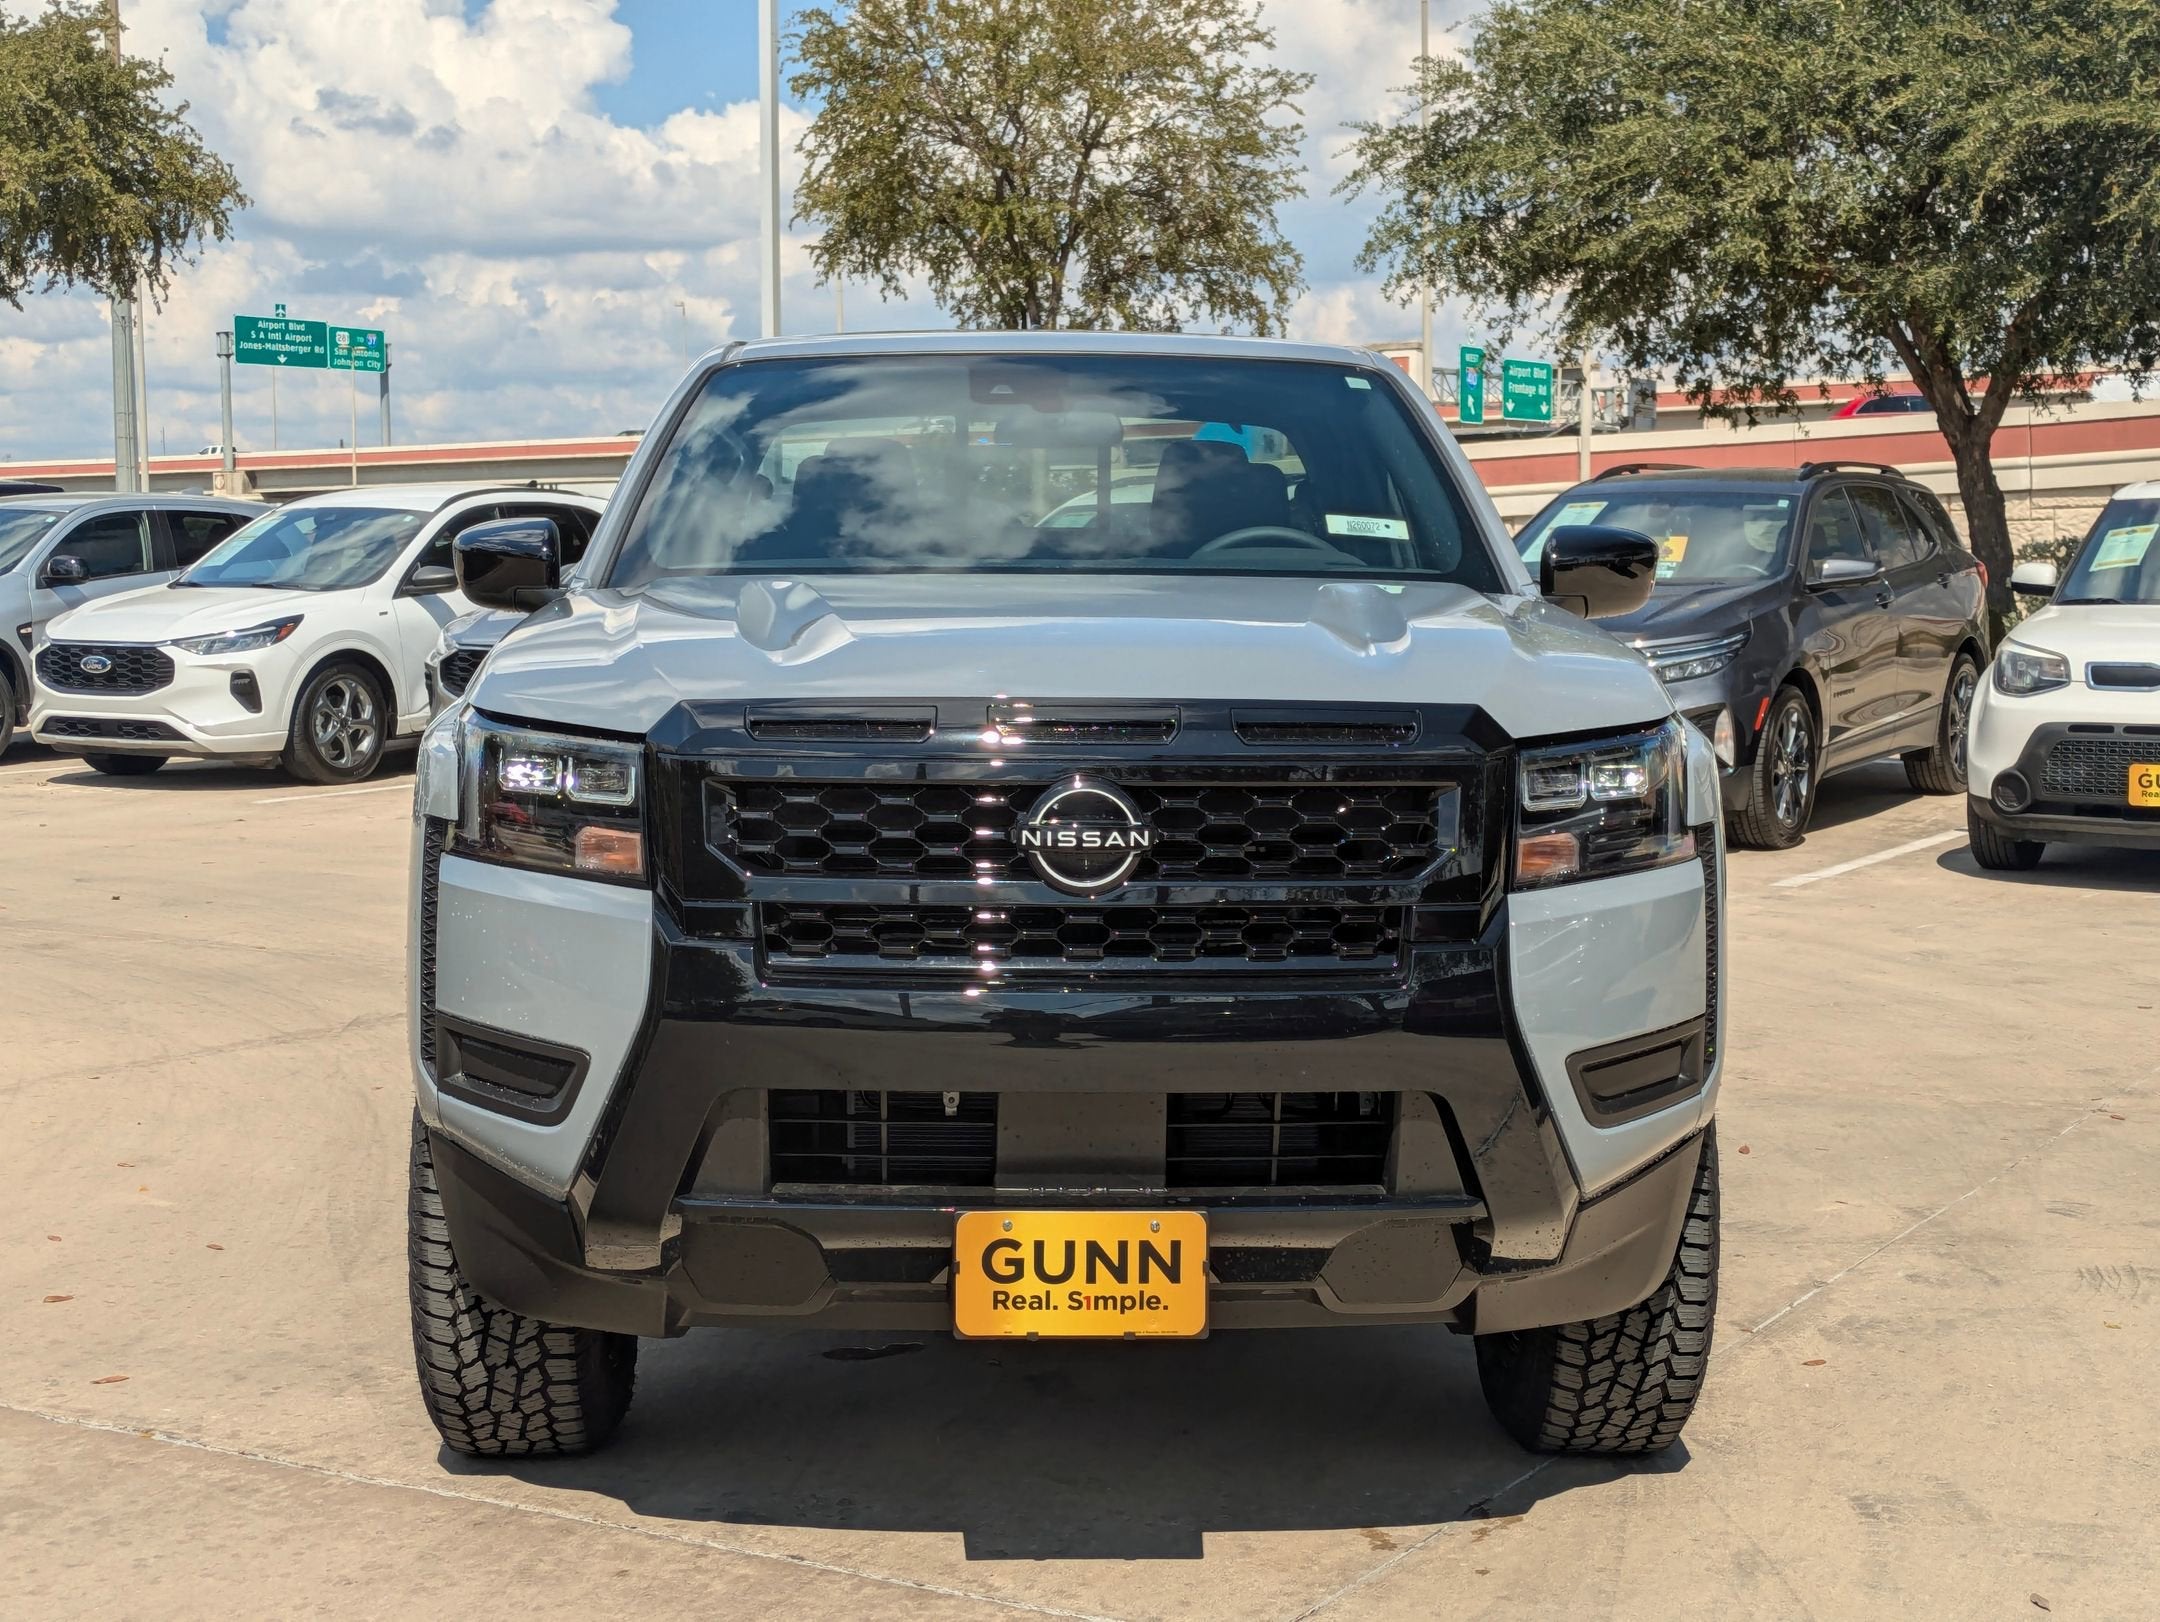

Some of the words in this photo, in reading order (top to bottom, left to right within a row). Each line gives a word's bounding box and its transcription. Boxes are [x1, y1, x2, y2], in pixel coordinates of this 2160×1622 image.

[257, 320, 285, 331] Airport
[288, 321, 306, 331] Blvd
[250, 330, 256, 339] S
[259, 331, 265, 339] A
[268, 332, 282, 341] Intl
[284, 332, 313, 344] Airport
[239, 340, 312, 355] Jones-Maltsberger
[314, 345, 325, 354] Rd
[334, 347, 348, 356] San
[366, 359, 381, 370] City
[1509, 365, 1531, 378] Airport
[1533, 367, 1547, 379] Blvd
[1508, 382, 1536, 397] Frontage
[1538, 384, 1547, 396] Rd
[1021, 830, 1149, 847] NISSAN
[981, 1238, 1181, 1285] GUNN
[992, 1290, 1059, 1311] Real.
